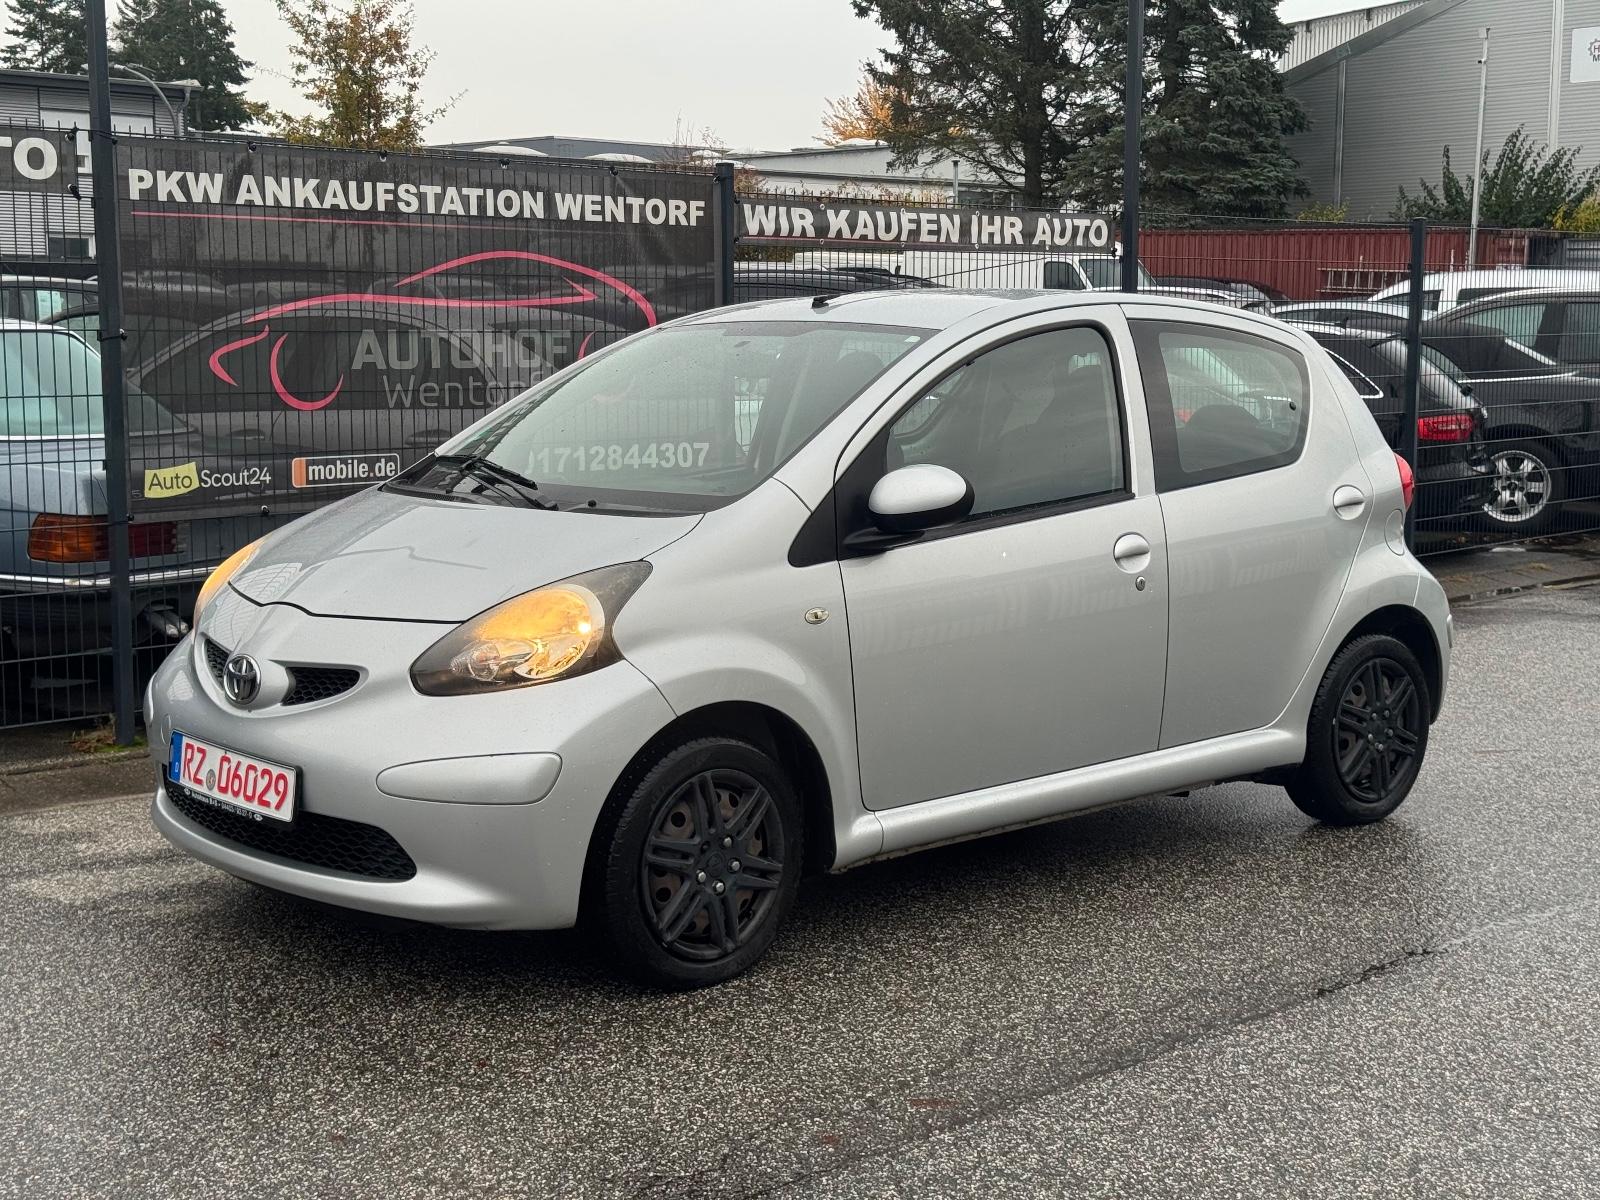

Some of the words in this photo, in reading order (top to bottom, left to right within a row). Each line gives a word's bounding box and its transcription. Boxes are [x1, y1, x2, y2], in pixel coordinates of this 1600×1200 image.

[128, 168, 224, 204] PKW
[235, 174, 545, 220] ANKAUFSTATION
[554, 192, 706, 227] WENTORF
[742, 203, 816, 238] WIR
[826, 208, 961, 244] KAUFEN
[970, 213, 1024, 246] IHR
[1031, 217, 1110, 248] AUTO
[351, 328, 572, 370] AUTOHOF
[308, 458, 396, 482] mobile.de
[183, 743, 206, 786] RZ
[217, 755, 288, 811] 06029
